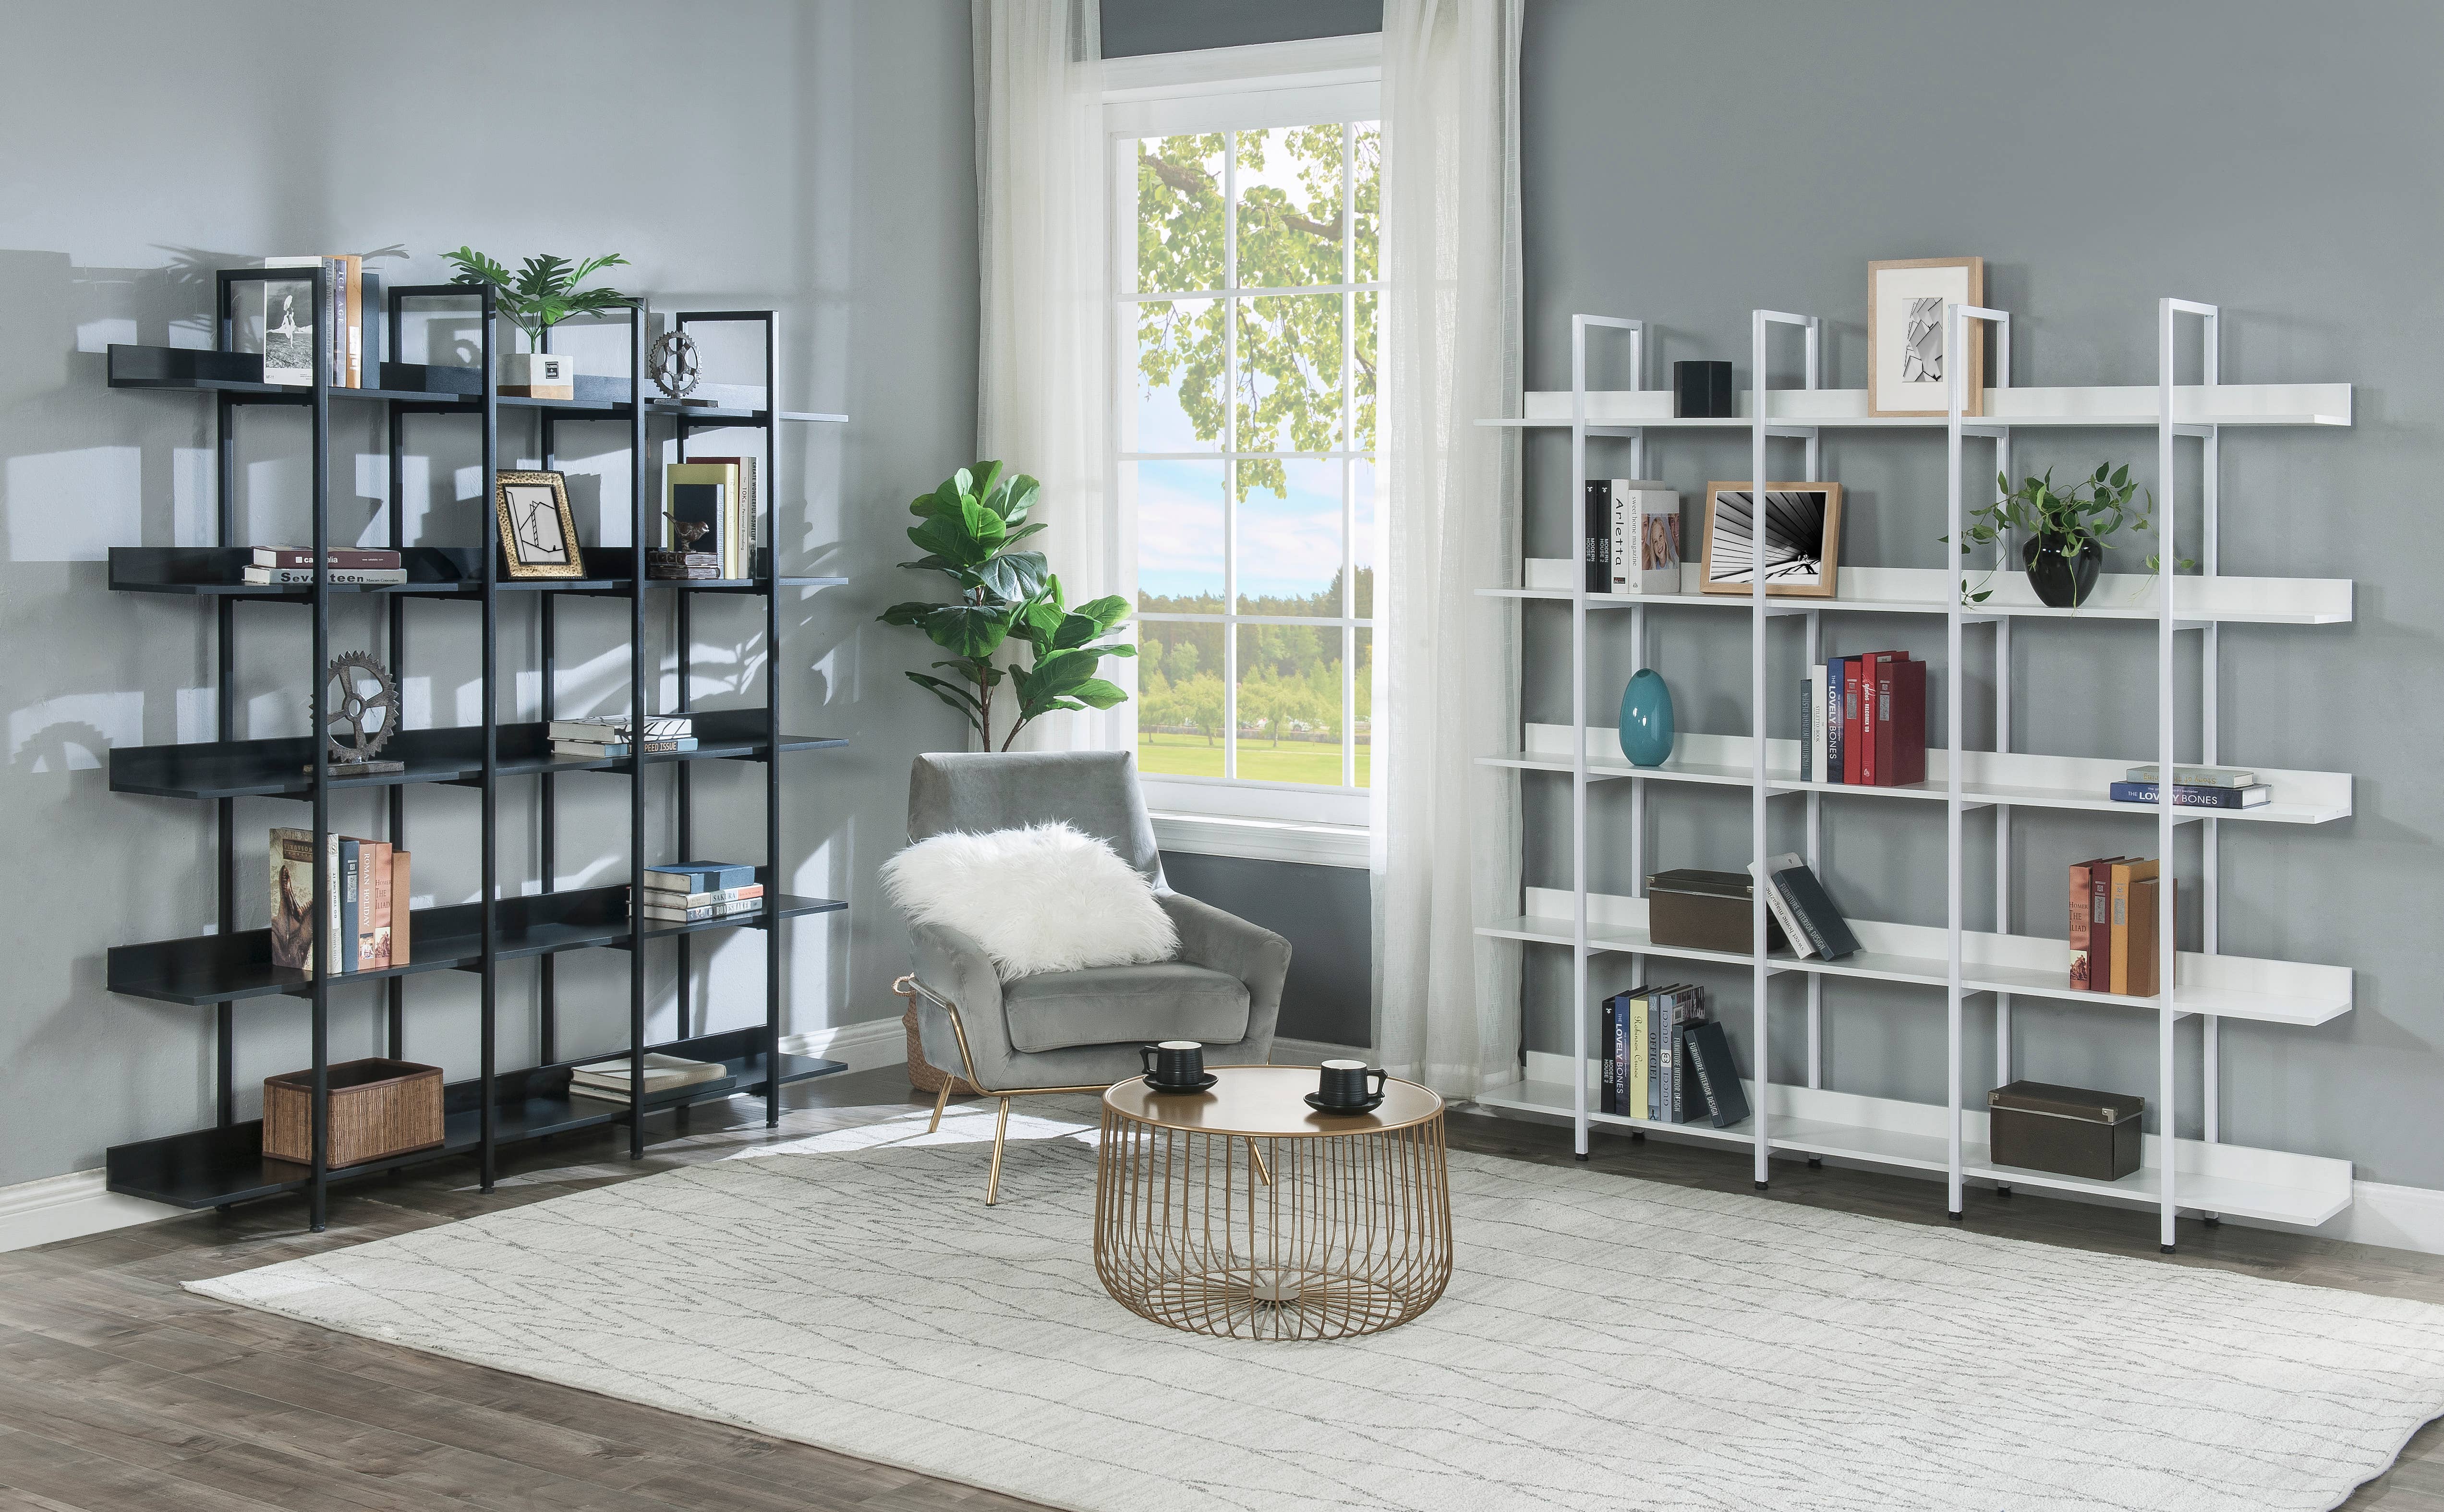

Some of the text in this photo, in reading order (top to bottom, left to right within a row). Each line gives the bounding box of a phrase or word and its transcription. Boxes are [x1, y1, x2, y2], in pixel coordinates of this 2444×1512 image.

[1615, 498, 1624, 565] Arletta
[280, 572, 363, 582] Sevteen
[644, 742, 677, 752] PEED ISSUE
[2139, 792, 2179, 802] LOVY
[2182, 795, 2217, 805] BONES
[375, 888, 387, 898] THE
[714, 892, 736, 902] SAKURA
[375, 899, 390, 909] ILIAD
[716, 901, 751, 915] BONESHAKER
[334, 910, 337, 918] DO
[1766, 886, 1805, 951] sweet home magazine
[1779, 883, 1826, 951] FURNITURE INTERIOR DESIGN
[2069, 910, 2082, 920] THE
[2069, 921, 2087, 932] ILIAD
[1634, 1016, 1643, 1078] Robinson Crusoe
[1689, 1042, 1719, 1116] FURNITURE INTERIOR DESIGN
